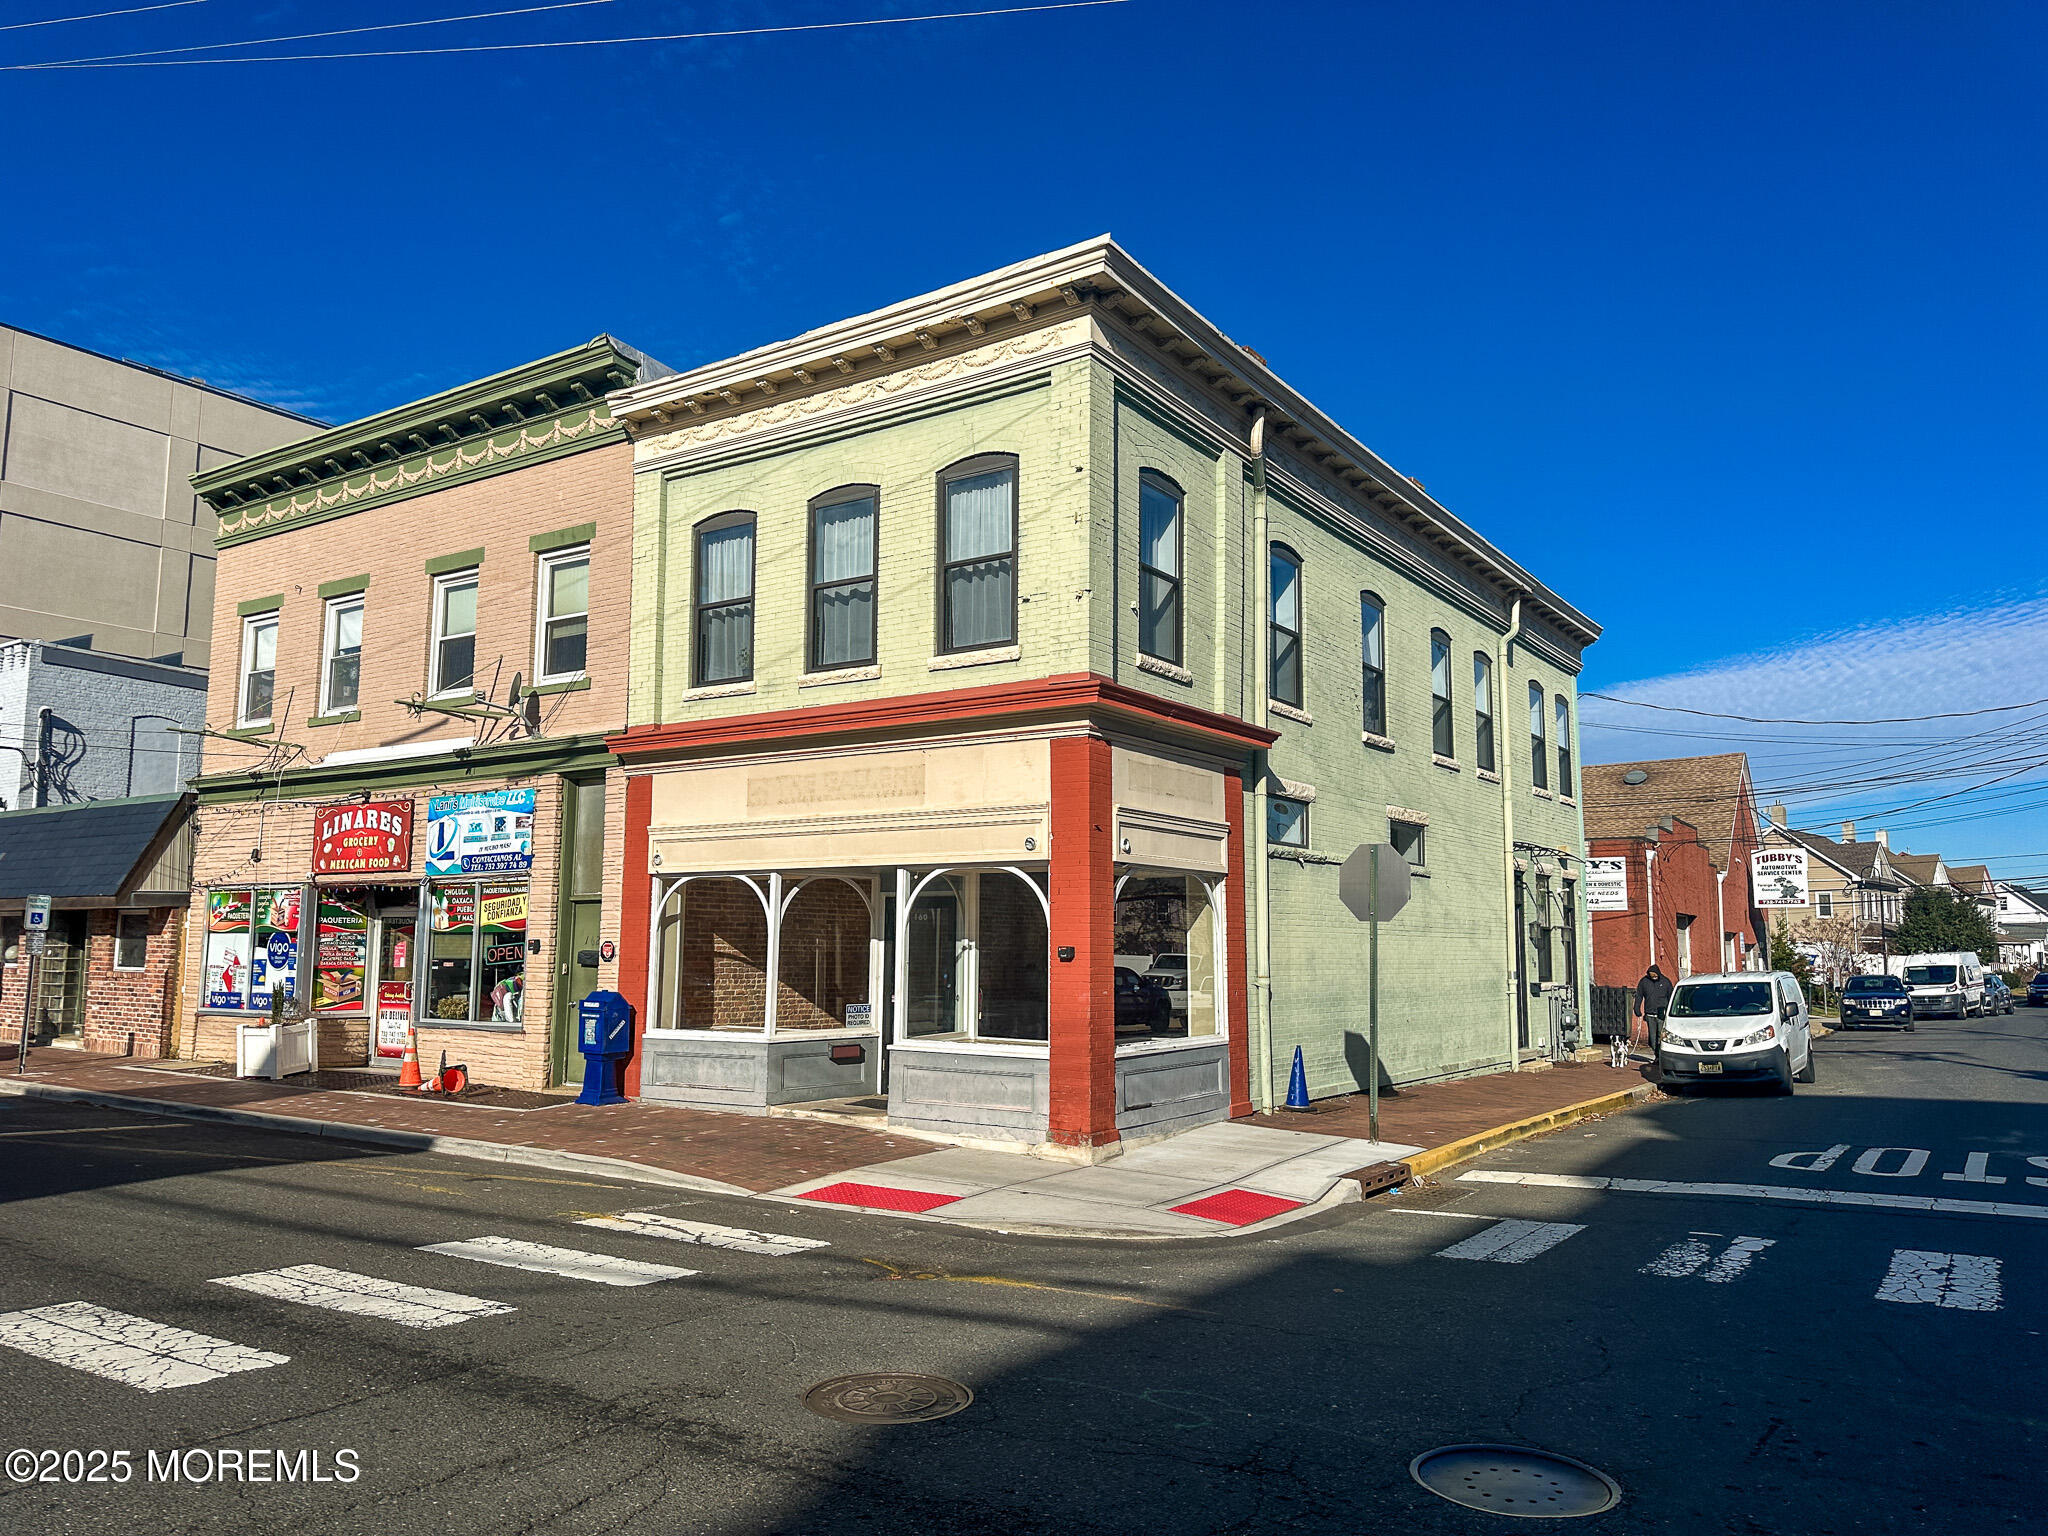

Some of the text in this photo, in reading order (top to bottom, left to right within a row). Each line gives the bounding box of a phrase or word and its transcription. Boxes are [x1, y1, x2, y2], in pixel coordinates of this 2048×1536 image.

[435, 798, 458, 811] Lani's
[322, 809, 402, 841] LINARES
[343, 835, 379, 848] GROCERY
[330, 857, 390, 870] MEXICAN FOOD
[1755, 853, 1802, 865] TUBBY'S
[484, 862, 495, 870] 732
[484, 896, 527, 912] SEGURIDAD Y
[486, 906, 522, 920] CONFIANZA
[270, 940, 289, 955] vigo
[488, 946, 523, 962] OPEN
[212, 993, 226, 1006] vigo
[252, 994, 268, 1007] vigo
[381, 1011, 408, 1020] WE DELIVER
